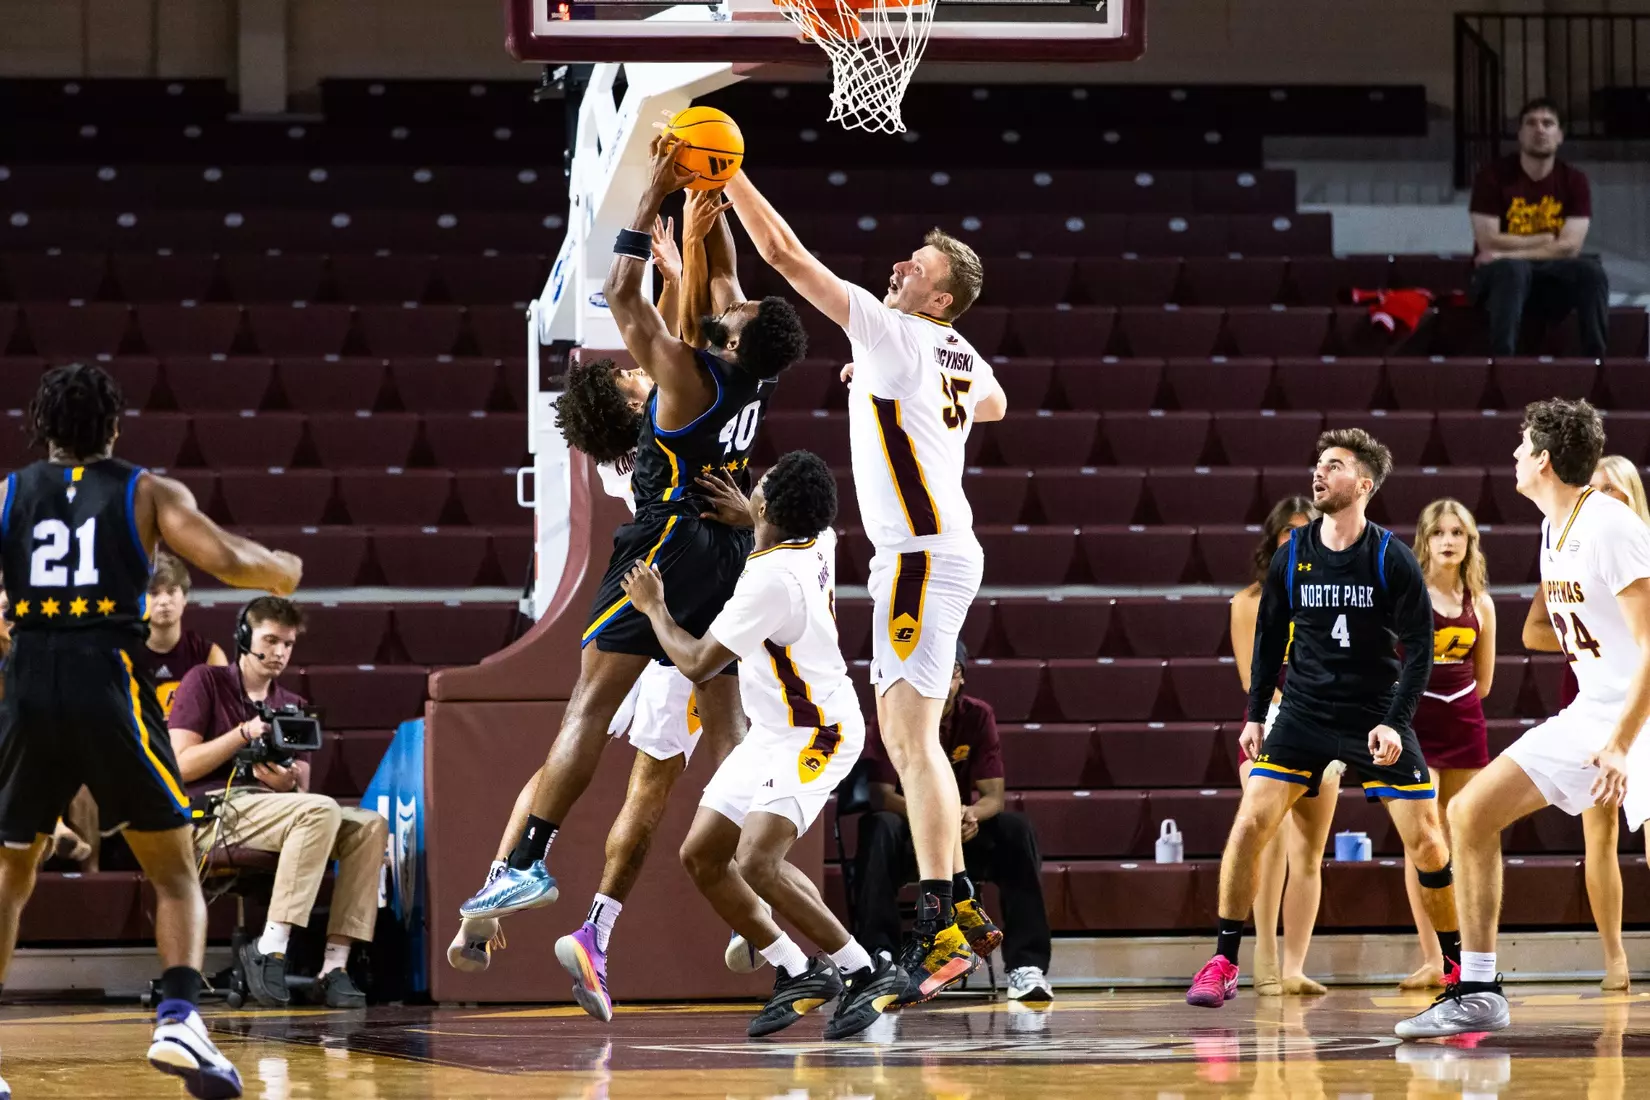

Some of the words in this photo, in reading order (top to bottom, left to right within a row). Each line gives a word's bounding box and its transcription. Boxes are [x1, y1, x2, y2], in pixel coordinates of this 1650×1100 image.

[719, 400, 761, 454] 40
[30, 517, 99, 587] 21
[1301, 585, 1340, 607] NORTH
[1344, 585, 1374, 607] PARK
[1331, 614, 1350, 647] 4
[1552, 612, 1601, 662] 24
